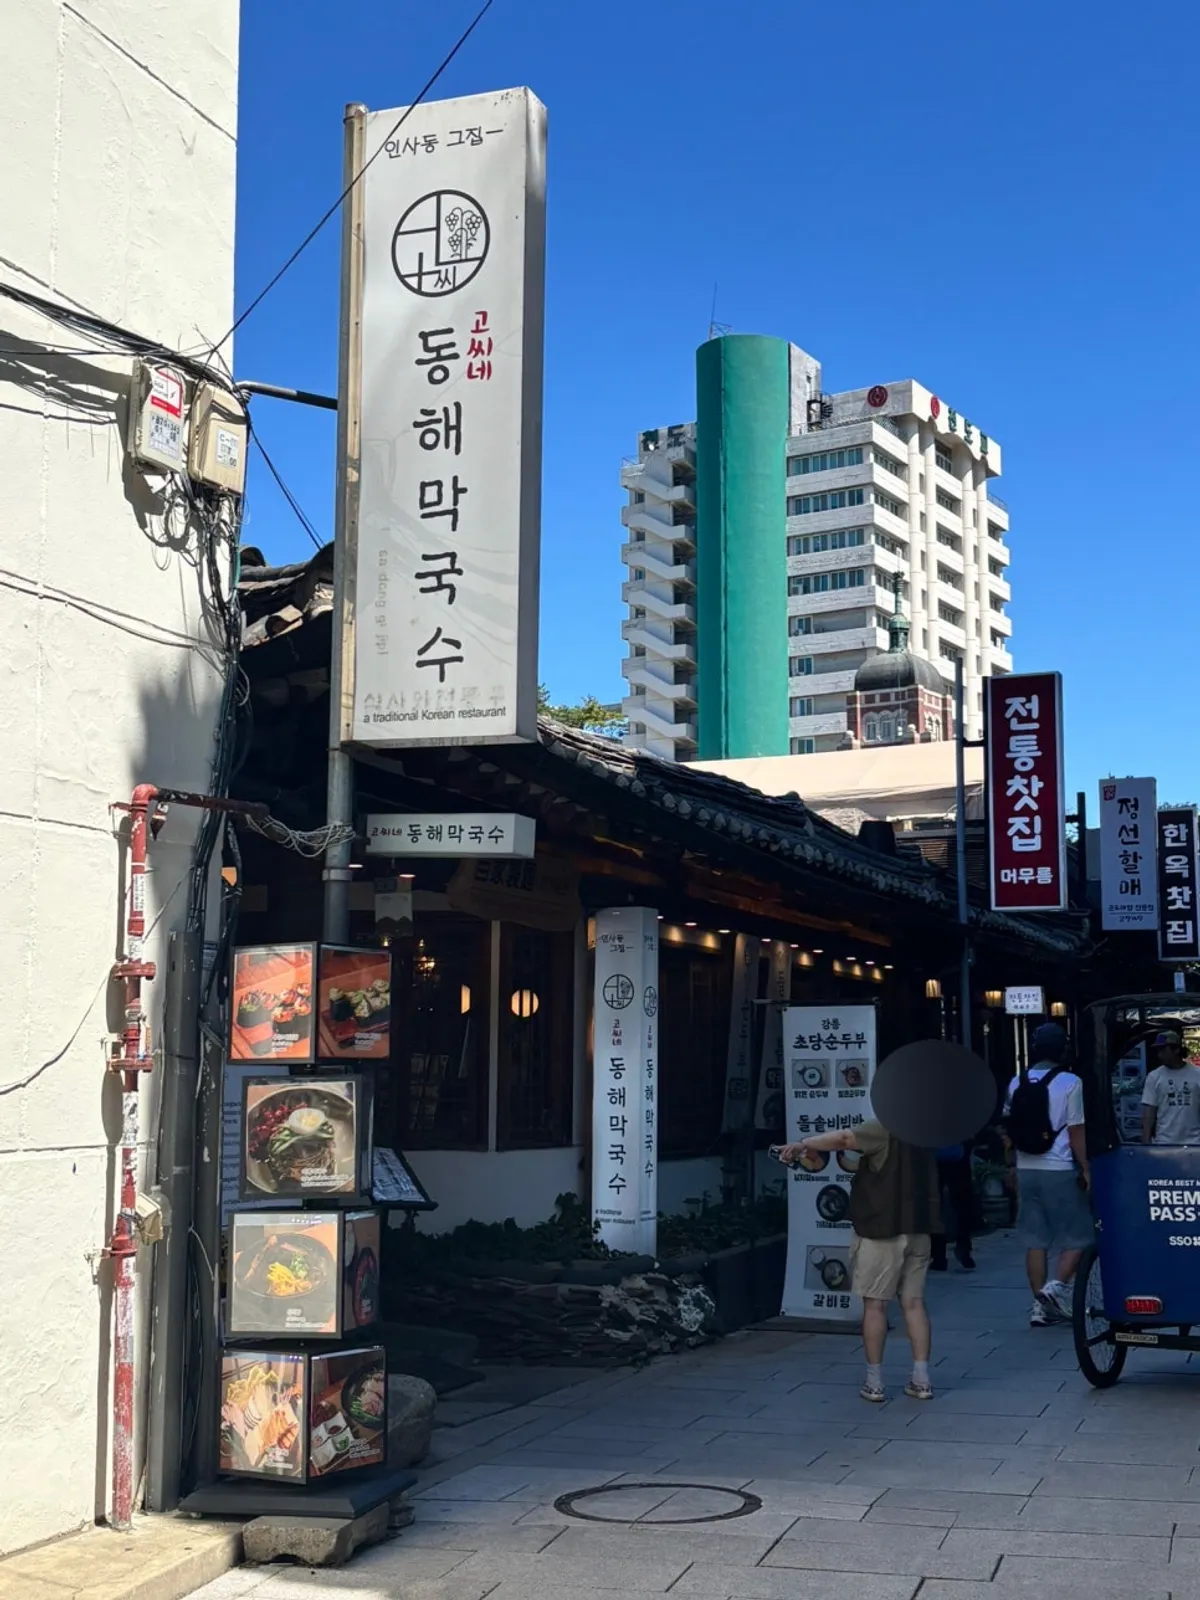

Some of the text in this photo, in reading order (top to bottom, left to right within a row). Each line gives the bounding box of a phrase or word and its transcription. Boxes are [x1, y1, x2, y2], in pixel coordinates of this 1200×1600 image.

[384, 134, 439, 159] 인사동
[466, 311, 493, 381] 고씨네
[412, 327, 468, 683] 동해막국수
[363, 705, 507, 723] a traditional Korean restaurant
[1004, 694, 1044, 852] 전통찻집
[370, 823, 505, 844] 고씨네 동해막국수
[1117, 797, 1143, 896] 정선할매
[1162, 823, 1194, 945] 한옥찻집
[821, 1018, 841, 1030] 강릉
[793, 1032, 867, 1051] 초당순두부
[607, 1057, 628, 1195] 동해막국수
[1147, 1179, 1174, 1187] KOREA
[1175, 1179, 1195, 1187] BEST
[813, 1294, 850, 1308] 갈비탕
